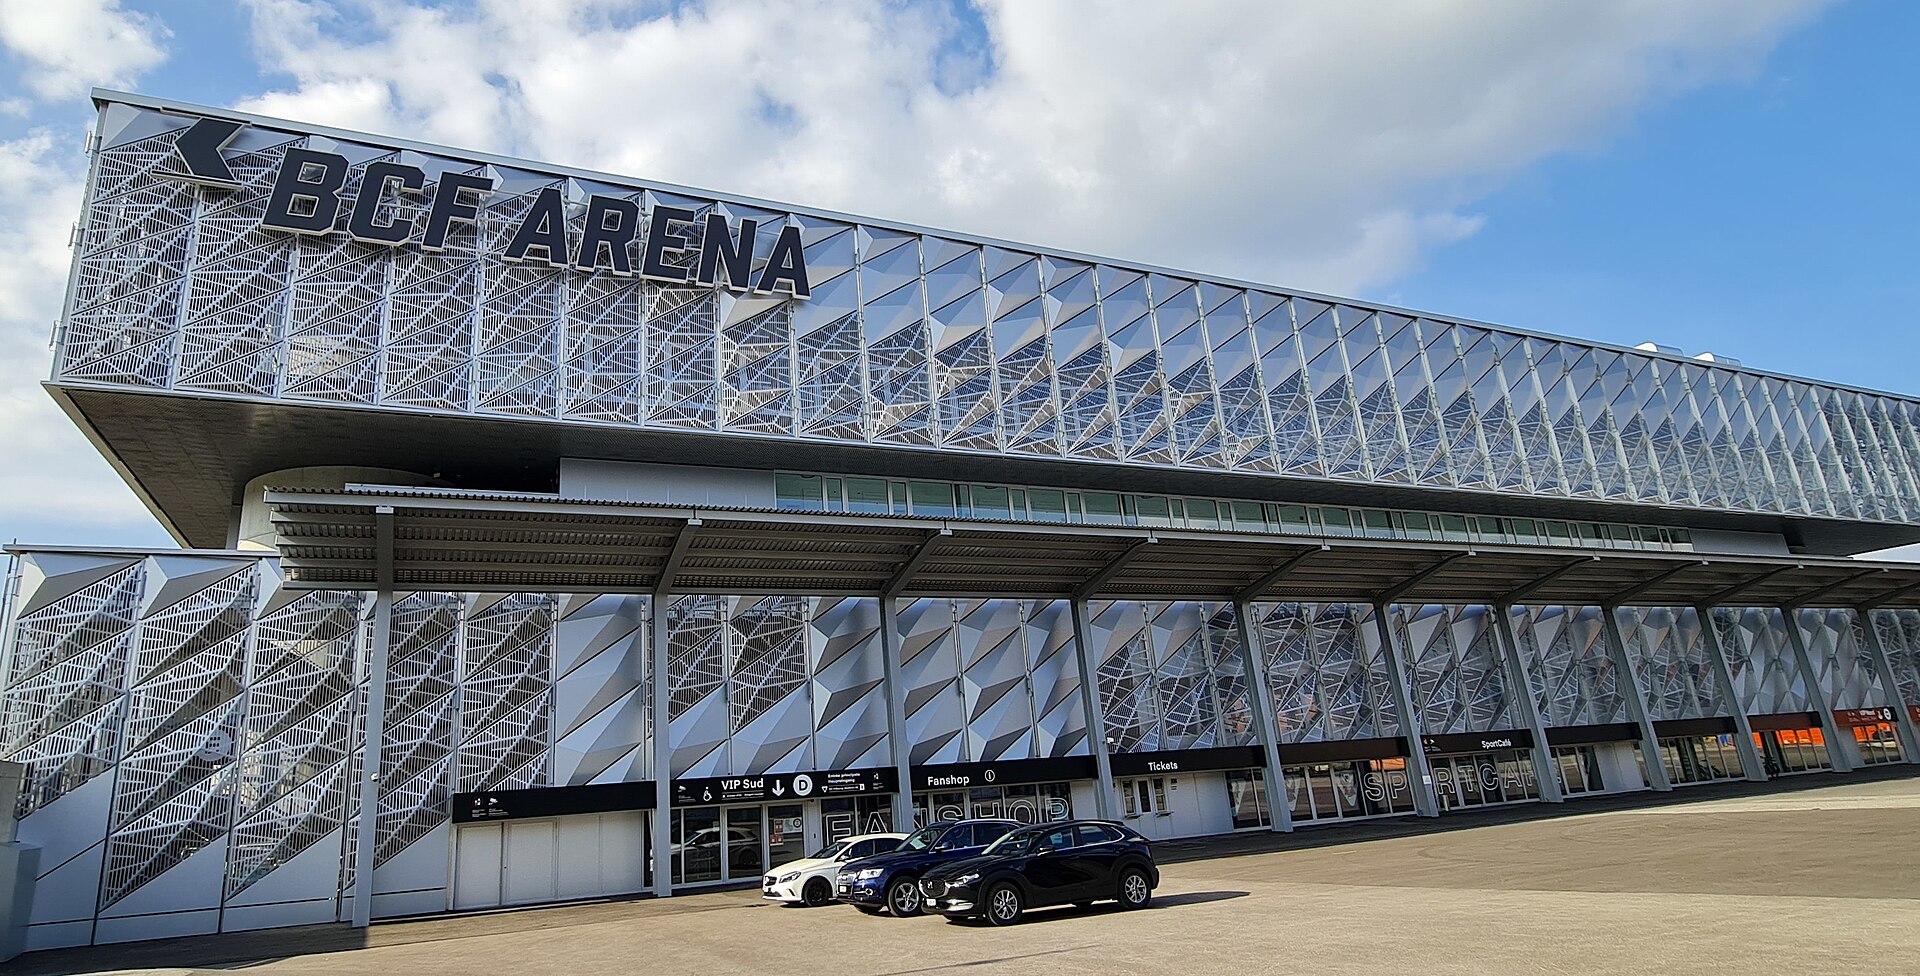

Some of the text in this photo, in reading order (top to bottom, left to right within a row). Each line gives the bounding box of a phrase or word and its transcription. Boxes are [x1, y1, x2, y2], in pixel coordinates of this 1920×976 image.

[260, 146, 811, 300] BCF ARENA
[1481, 738, 1512, 750] SportCafé
[1148, 761, 1178, 771] Tickets
[721, 777, 764, 790] VIP Sud
[927, 774, 970, 787] Fanshop
[1363, 762, 1562, 801] SPRTCAF
